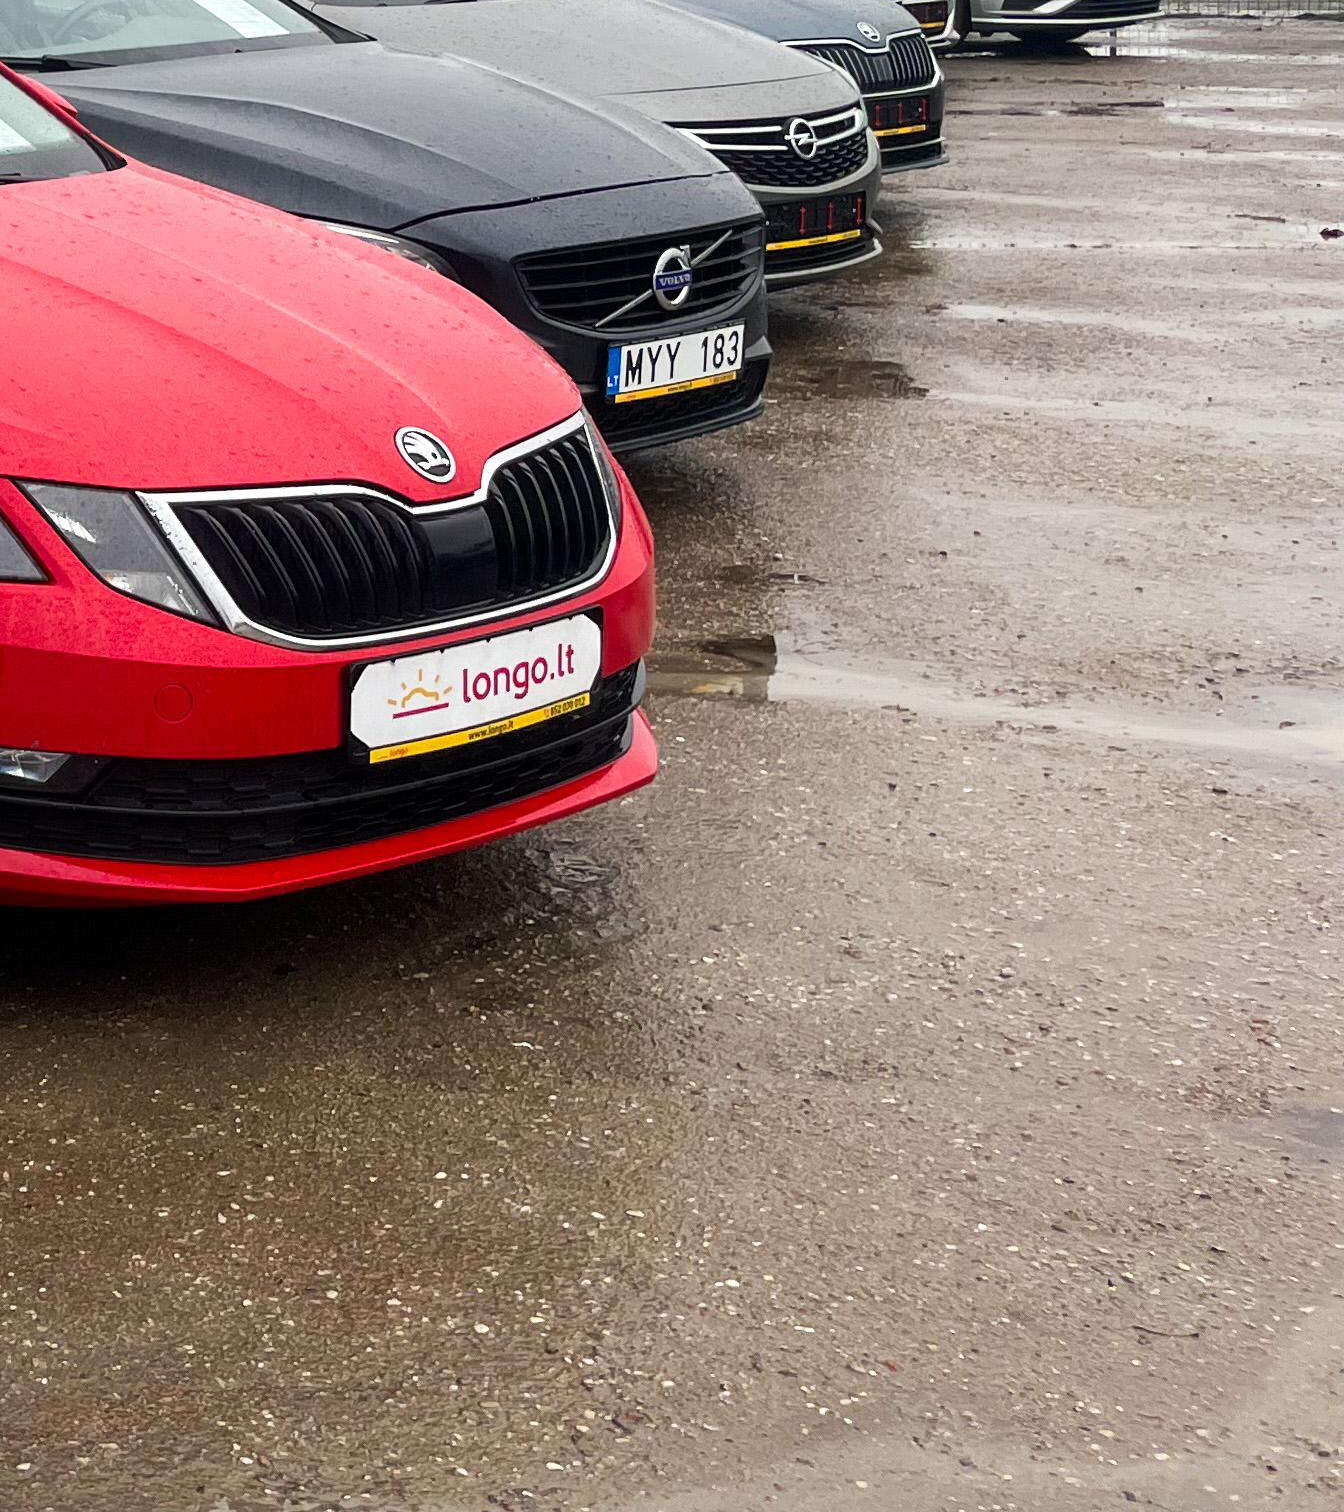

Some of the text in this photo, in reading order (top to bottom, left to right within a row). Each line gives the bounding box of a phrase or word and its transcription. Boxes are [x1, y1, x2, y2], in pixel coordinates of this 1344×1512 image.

[659, 273, 691, 287] VOLVO
[607, 330, 739, 388] LT MYY 183
[462, 643, 574, 703] longo.lt
